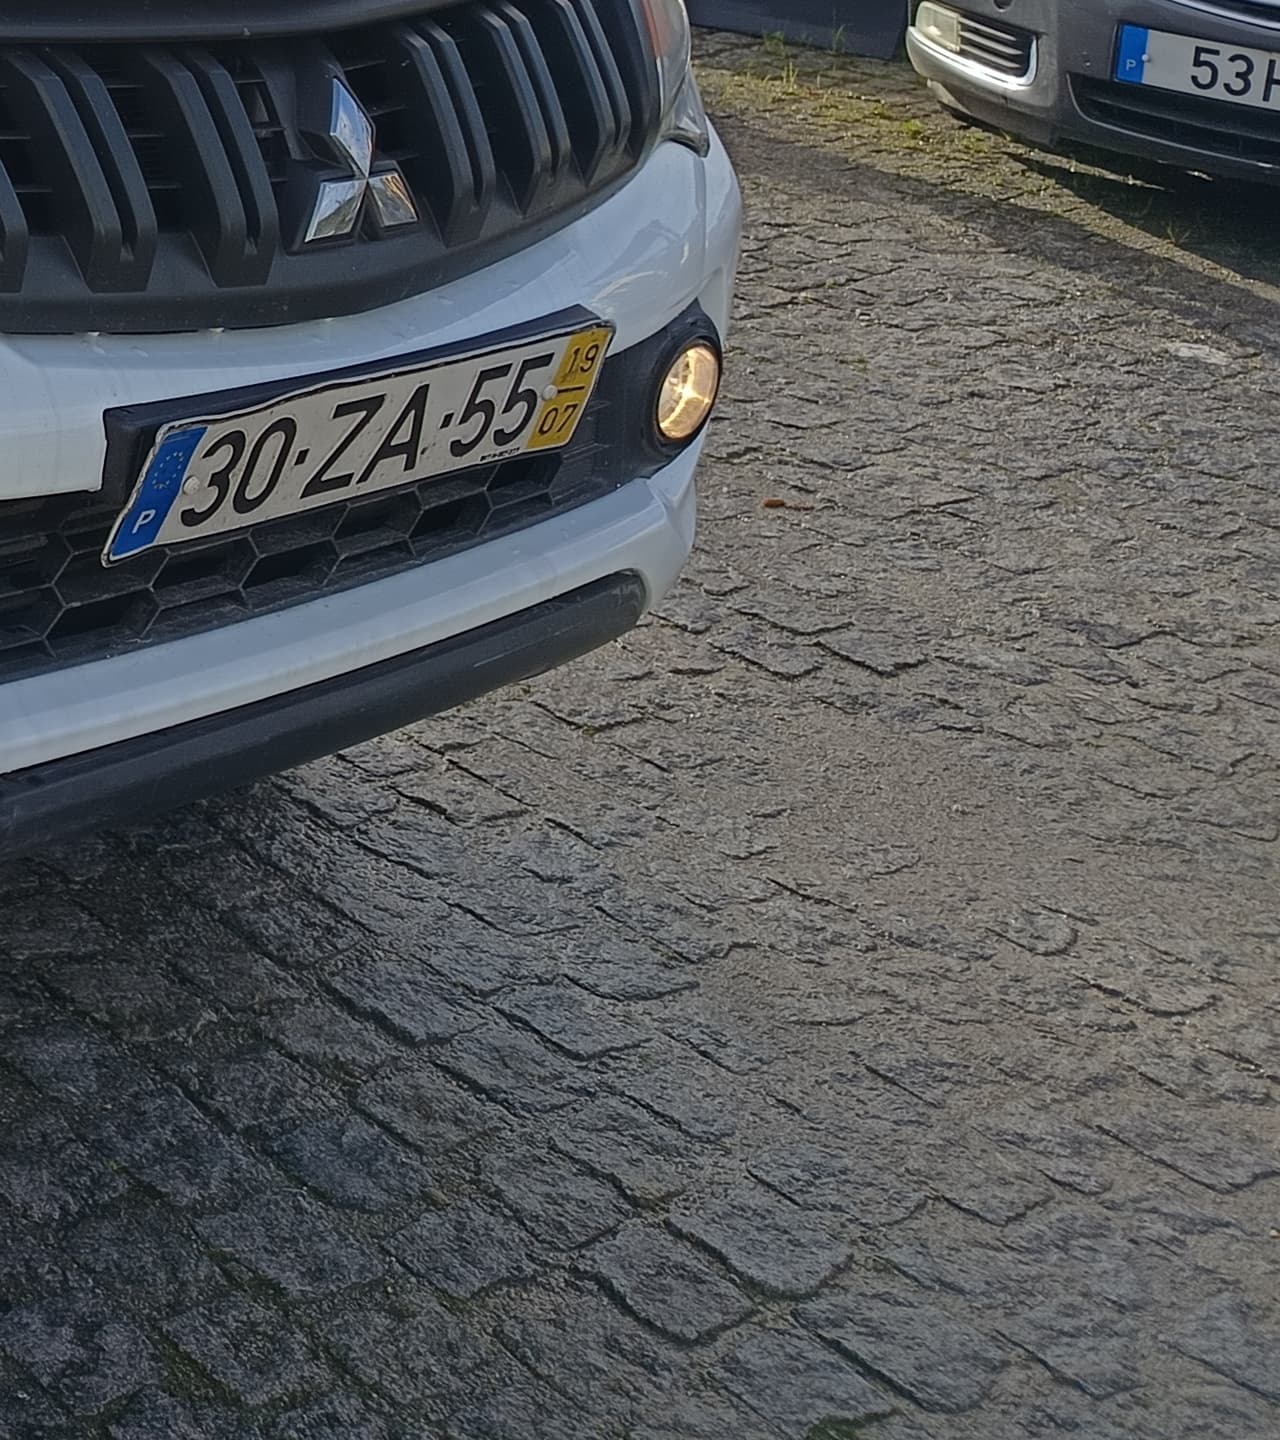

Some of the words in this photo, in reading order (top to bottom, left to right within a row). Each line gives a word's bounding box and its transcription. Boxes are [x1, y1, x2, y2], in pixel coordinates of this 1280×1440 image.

[1125, 60, 1137, 71] P
[567, 343, 600, 374] 19
[538, 403, 579, 435] 07
[132, 509, 156, 534] P
